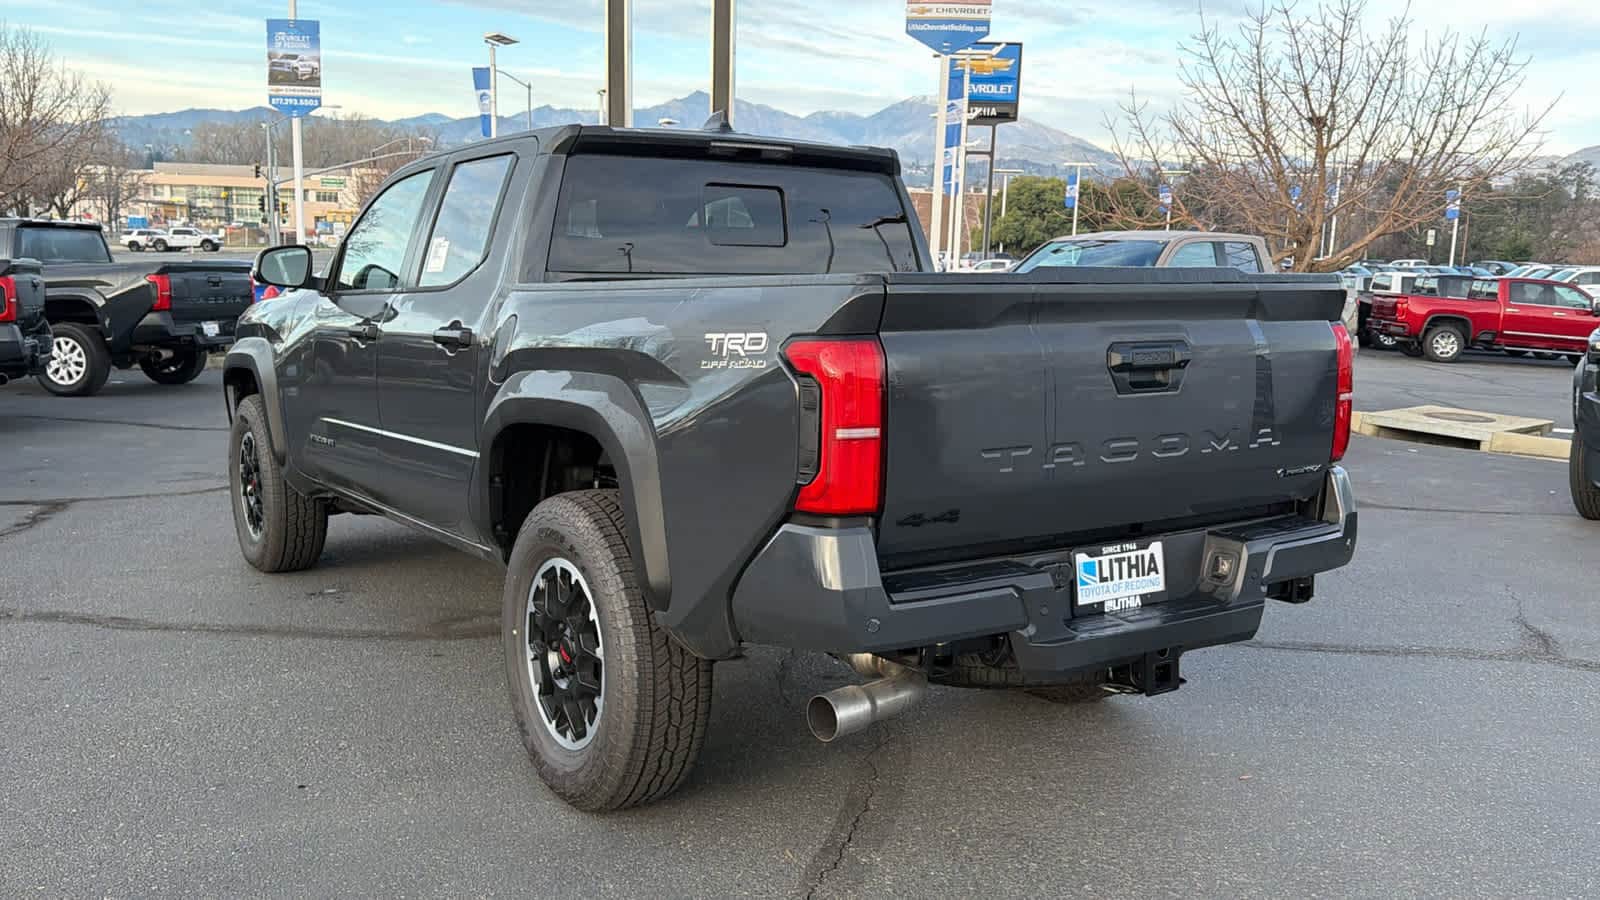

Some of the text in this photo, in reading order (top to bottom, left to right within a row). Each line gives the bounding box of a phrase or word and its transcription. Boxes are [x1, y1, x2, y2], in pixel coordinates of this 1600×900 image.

[936, 7, 988, 15] CHEVROLET
[968, 84, 1013, 94] EVROLET
[704, 332, 768, 357] TRD
[700, 358, 767, 369] OFF ROAD
[981, 423, 1281, 473] TACOMA
[1098, 553, 1159, 583] LITHIA
[1080, 576, 1161, 599] TOYOTA OF REDDING
[1113, 595, 1142, 610] LITHIA
